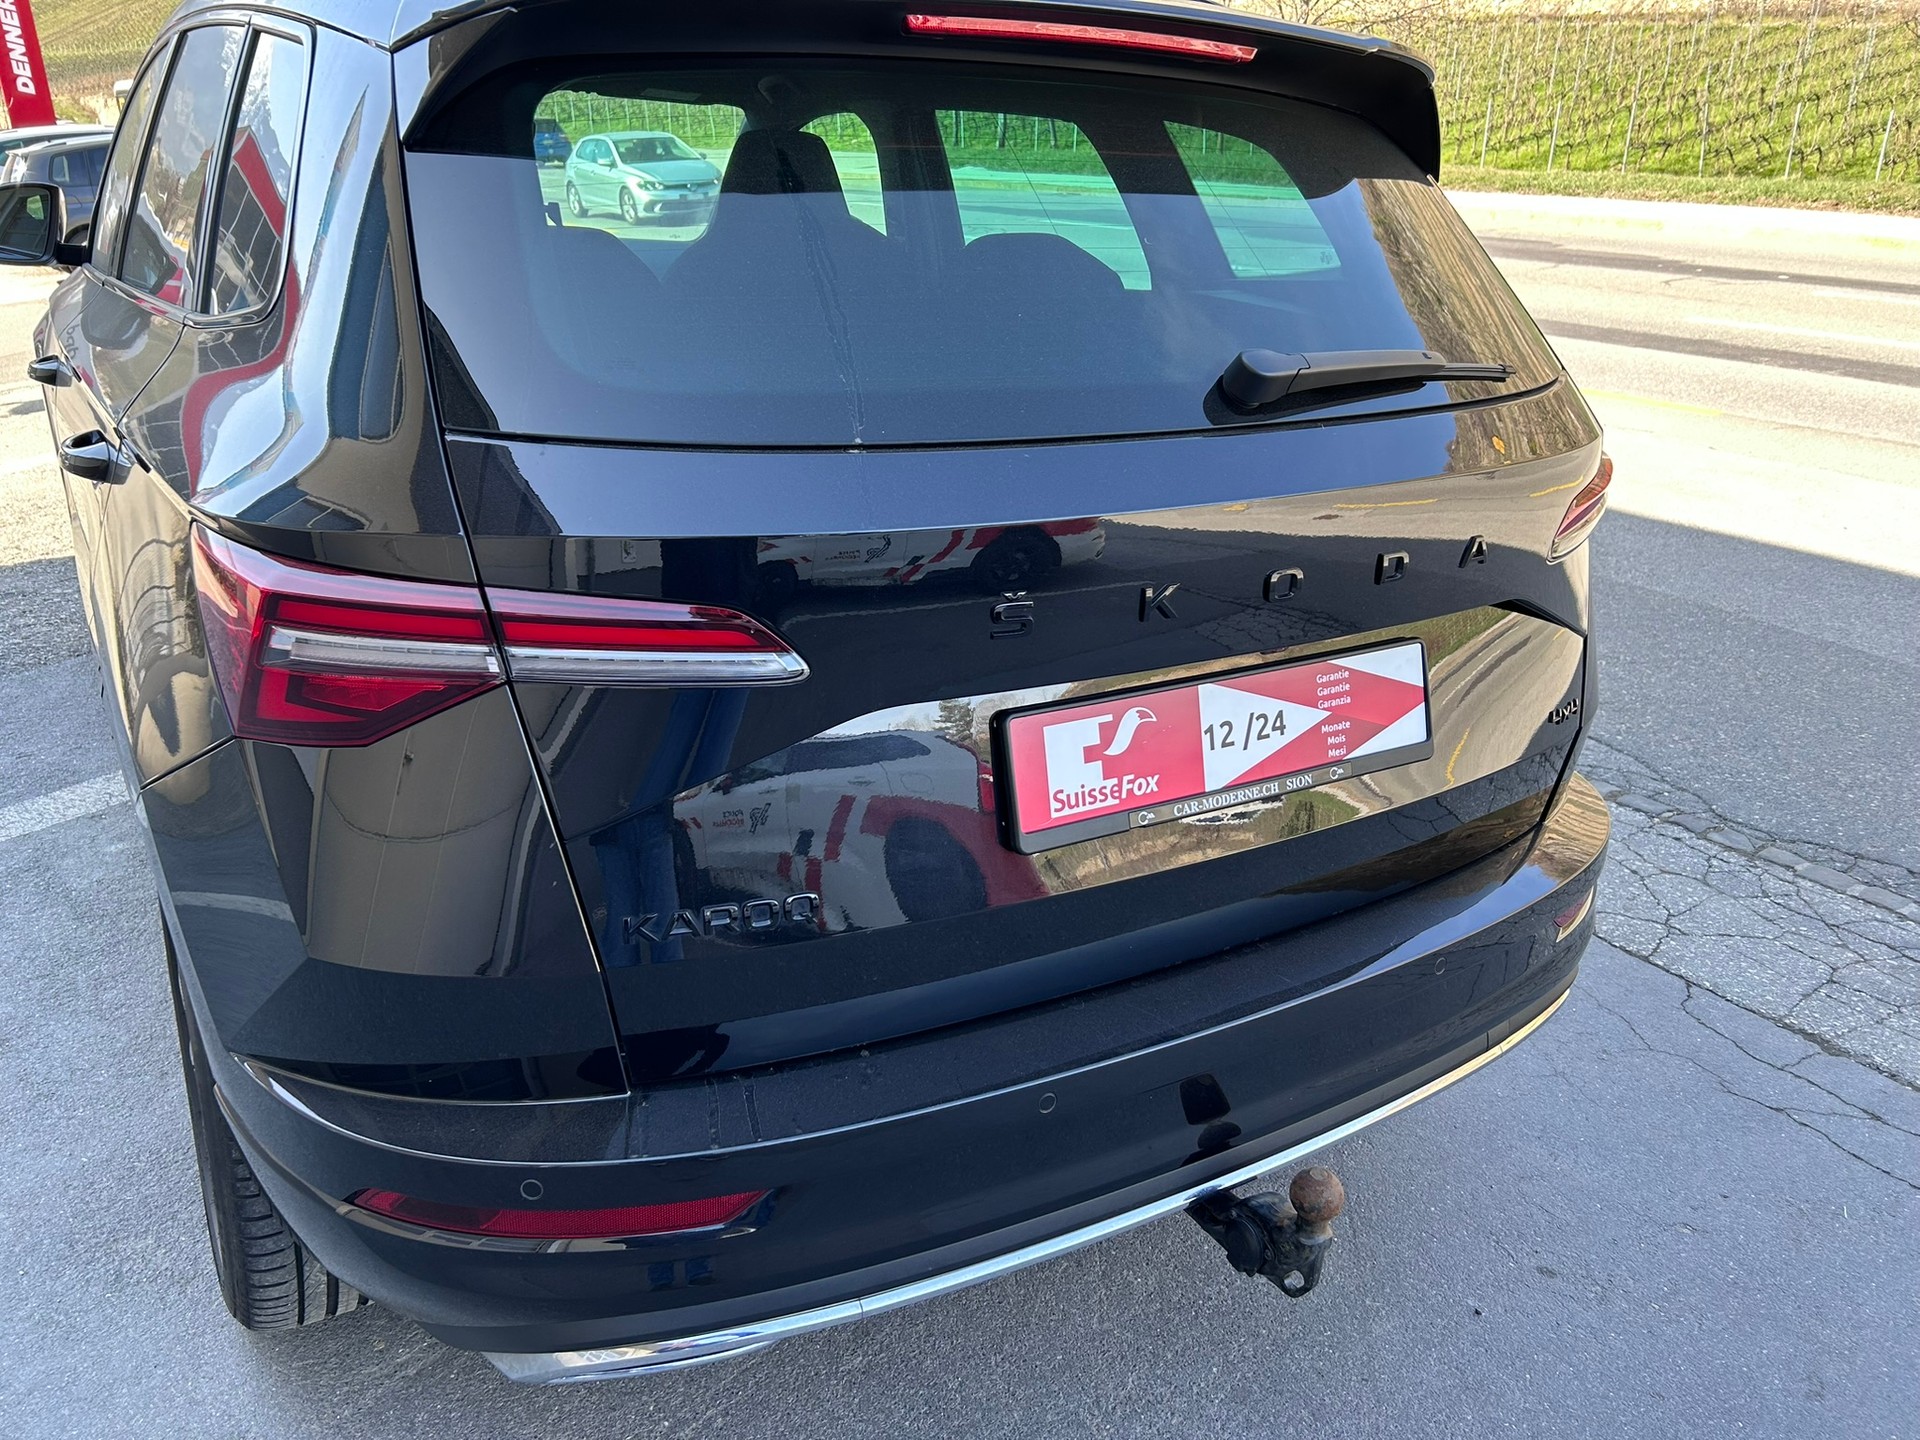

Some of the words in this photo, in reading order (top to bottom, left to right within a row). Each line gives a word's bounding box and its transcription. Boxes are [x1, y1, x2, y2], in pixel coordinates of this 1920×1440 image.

[989, 534, 1490, 640] ŠKODA
[1316, 669, 1350, 683] Garantie
[1317, 682, 1351, 696] Garantie
[1318, 695, 1351, 709] Garanzia
[1321, 720, 1351, 734] Monate
[1327, 733, 1346, 746] Mois
[1328, 745, 1347, 758] Mesi
[1173, 782, 1279, 816] CAR-MODERNE.CH
[1286, 773, 1313, 791] SION
[623, 892, 820, 945] KAROQ
